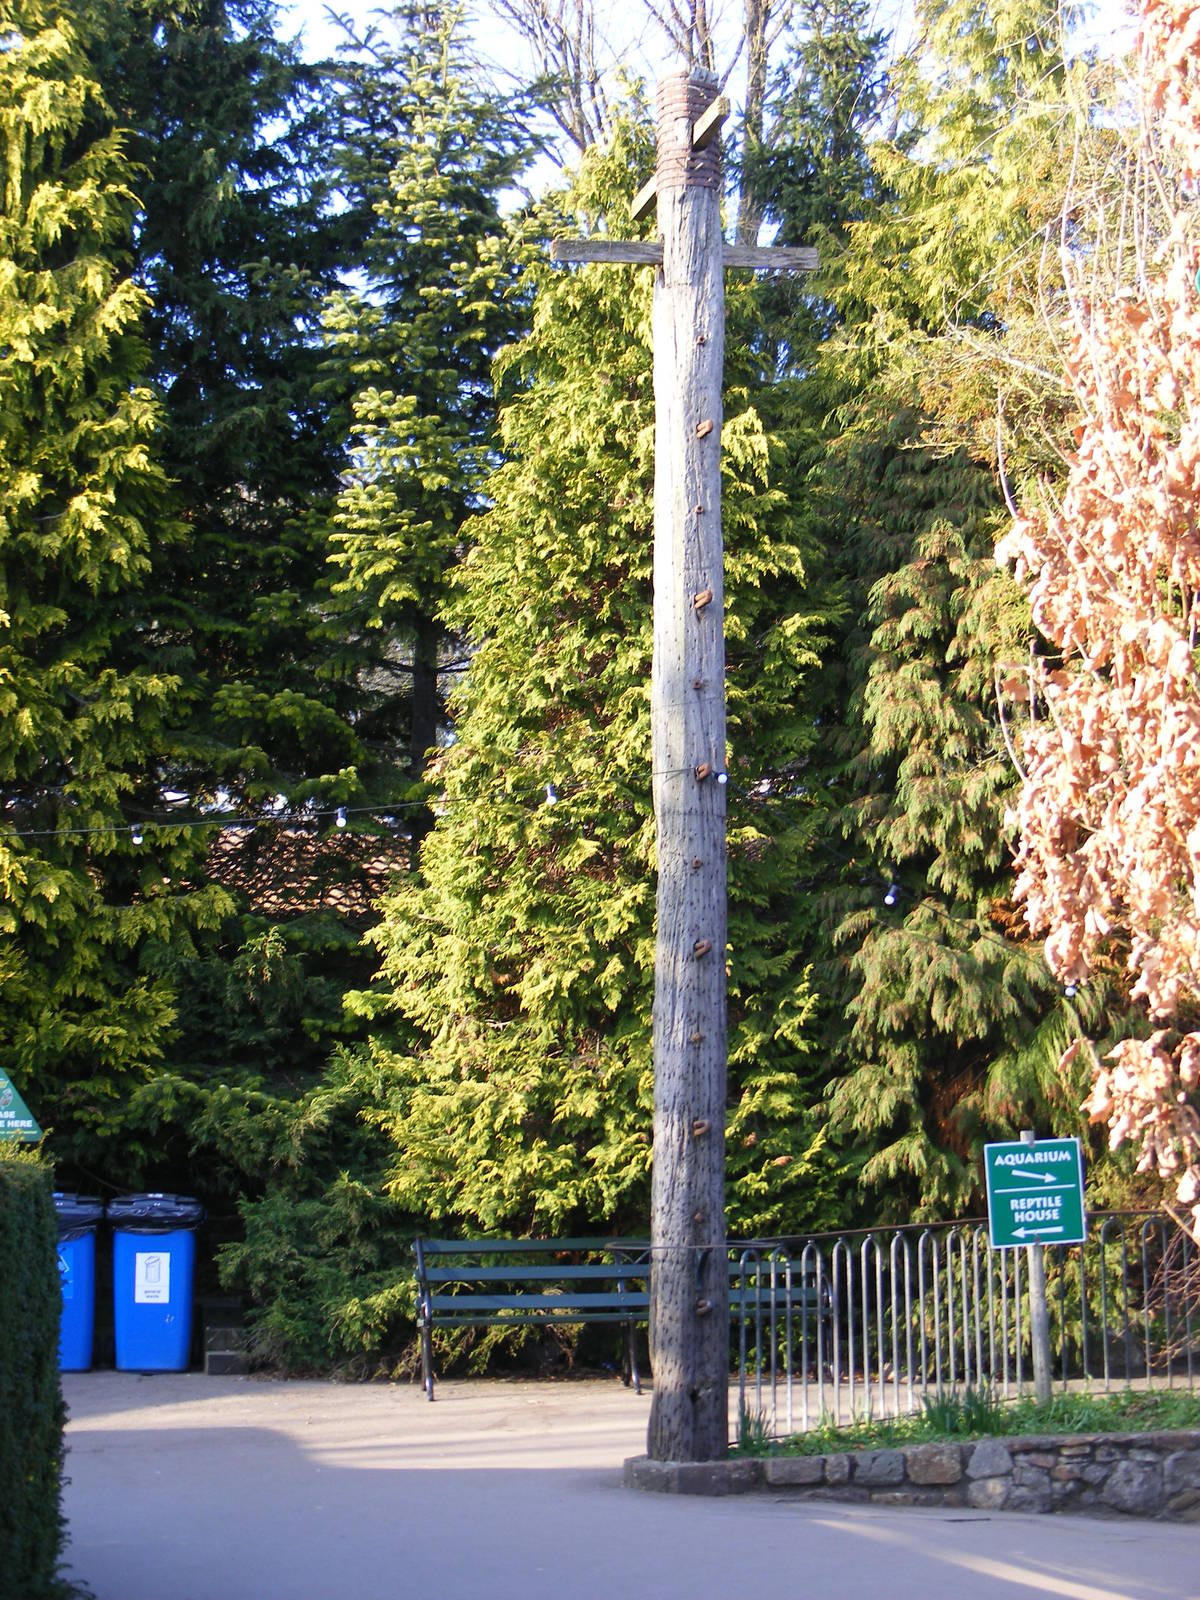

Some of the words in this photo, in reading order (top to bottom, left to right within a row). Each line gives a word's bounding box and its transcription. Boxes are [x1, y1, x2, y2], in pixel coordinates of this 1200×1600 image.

[7, 1119, 32, 1127] HERE
[994, 1151, 1071, 1166] AQUARIUM
[1010, 1196, 1062, 1210] REPTILE
[1014, 1209, 1059, 1222] HOUSE
